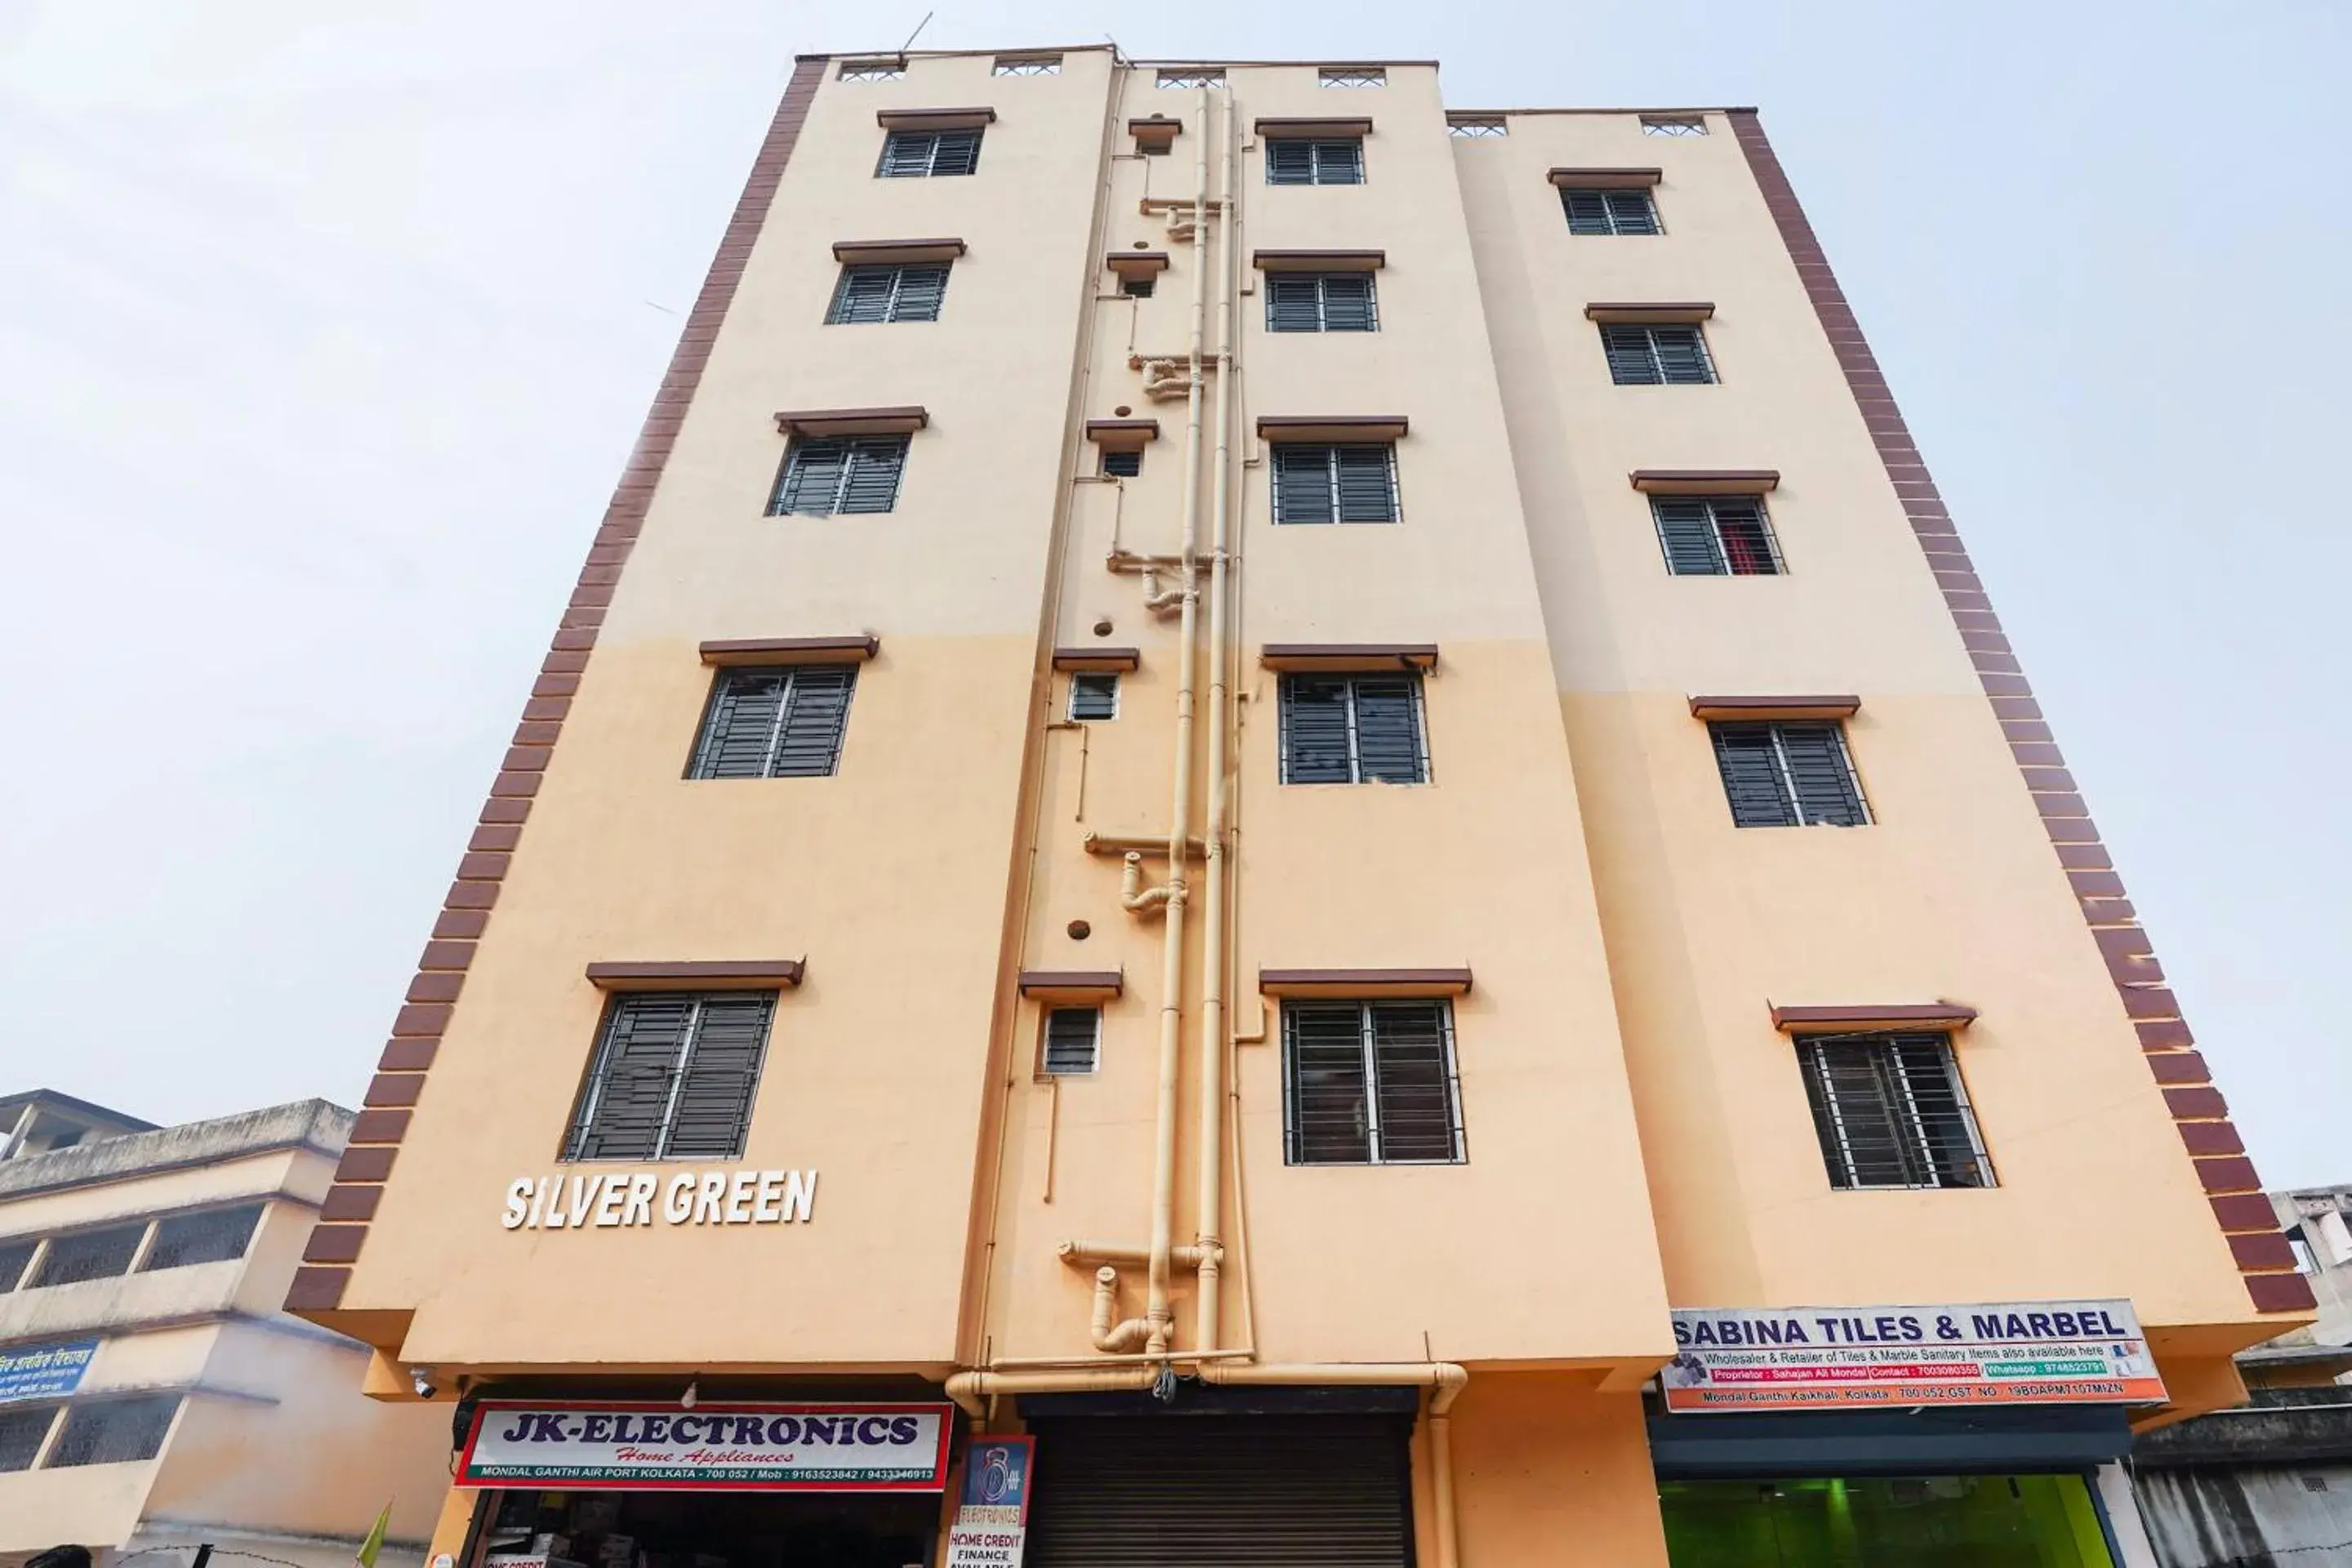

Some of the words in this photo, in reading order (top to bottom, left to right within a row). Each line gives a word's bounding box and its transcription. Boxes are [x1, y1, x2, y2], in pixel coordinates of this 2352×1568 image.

[501, 1174, 658, 1229] SILVER
[664, 1170, 817, 1225] GREEN
[1673, 1319, 1809, 1344] SABINA
[1815, 1316, 1923, 1343] TILES
[1936, 1315, 1962, 1340] &
[1971, 1311, 2125, 1339] MARBEL
[1704, 1353, 1766, 1365] Wholesaler
[1770, 1353, 1778, 1363] &
[1780, 1352, 1823, 1363] Retailer
[1826, 1352, 1836, 1361] of
[1839, 1350, 1866, 1361] Tiles
[1869, 1350, 1877, 1361] &
[1880, 1349, 1918, 1361] Marble
[1921, 1348, 1966, 1361] Sanitary
[1969, 1348, 1999, 1359] Items
[2002, 1348, 2025, 1358] also
[2029, 1346, 2077, 1357] available
[2079, 1345, 2105, 1356] here
[1715, 1370, 1763, 1380] Proprietor
[1831, 1367, 1867, 1378] Mondal
[1870, 1367, 1910, 1377] Contact
[1987, 1365, 2035, 1376] Whatsapp
[1704, 1392, 1744, 1401] Mondal
[1846, 1390, 1889, 1399] Kolkata
[1900, 1388, 1919, 1397] 700
[503, 1414, 918, 1446] JK-ELECTRONICS
[616, 1446, 674, 1463] Home
[679, 1448, 794, 1465] Appliances
[481, 1467, 531, 1477] MONDAL
[535, 1467, 580, 1477] GANTHI
[583, 1468, 603, 1477] AIR
[605, 1468, 640, 1477] PORT
[641, 1468, 696, 1478] KOLKATA
[706, 1469, 725, 1478] 700
[728, 1470, 747, 1479] 052
[757, 1469, 782, 1479] Mob
[792, 1470, 858, 1479] 9163523842
[951, 1532, 982, 1546] HOME
[984, 1534, 1021, 1548] CREDIT
[957, 1550, 1009, 1561] FINANCE
